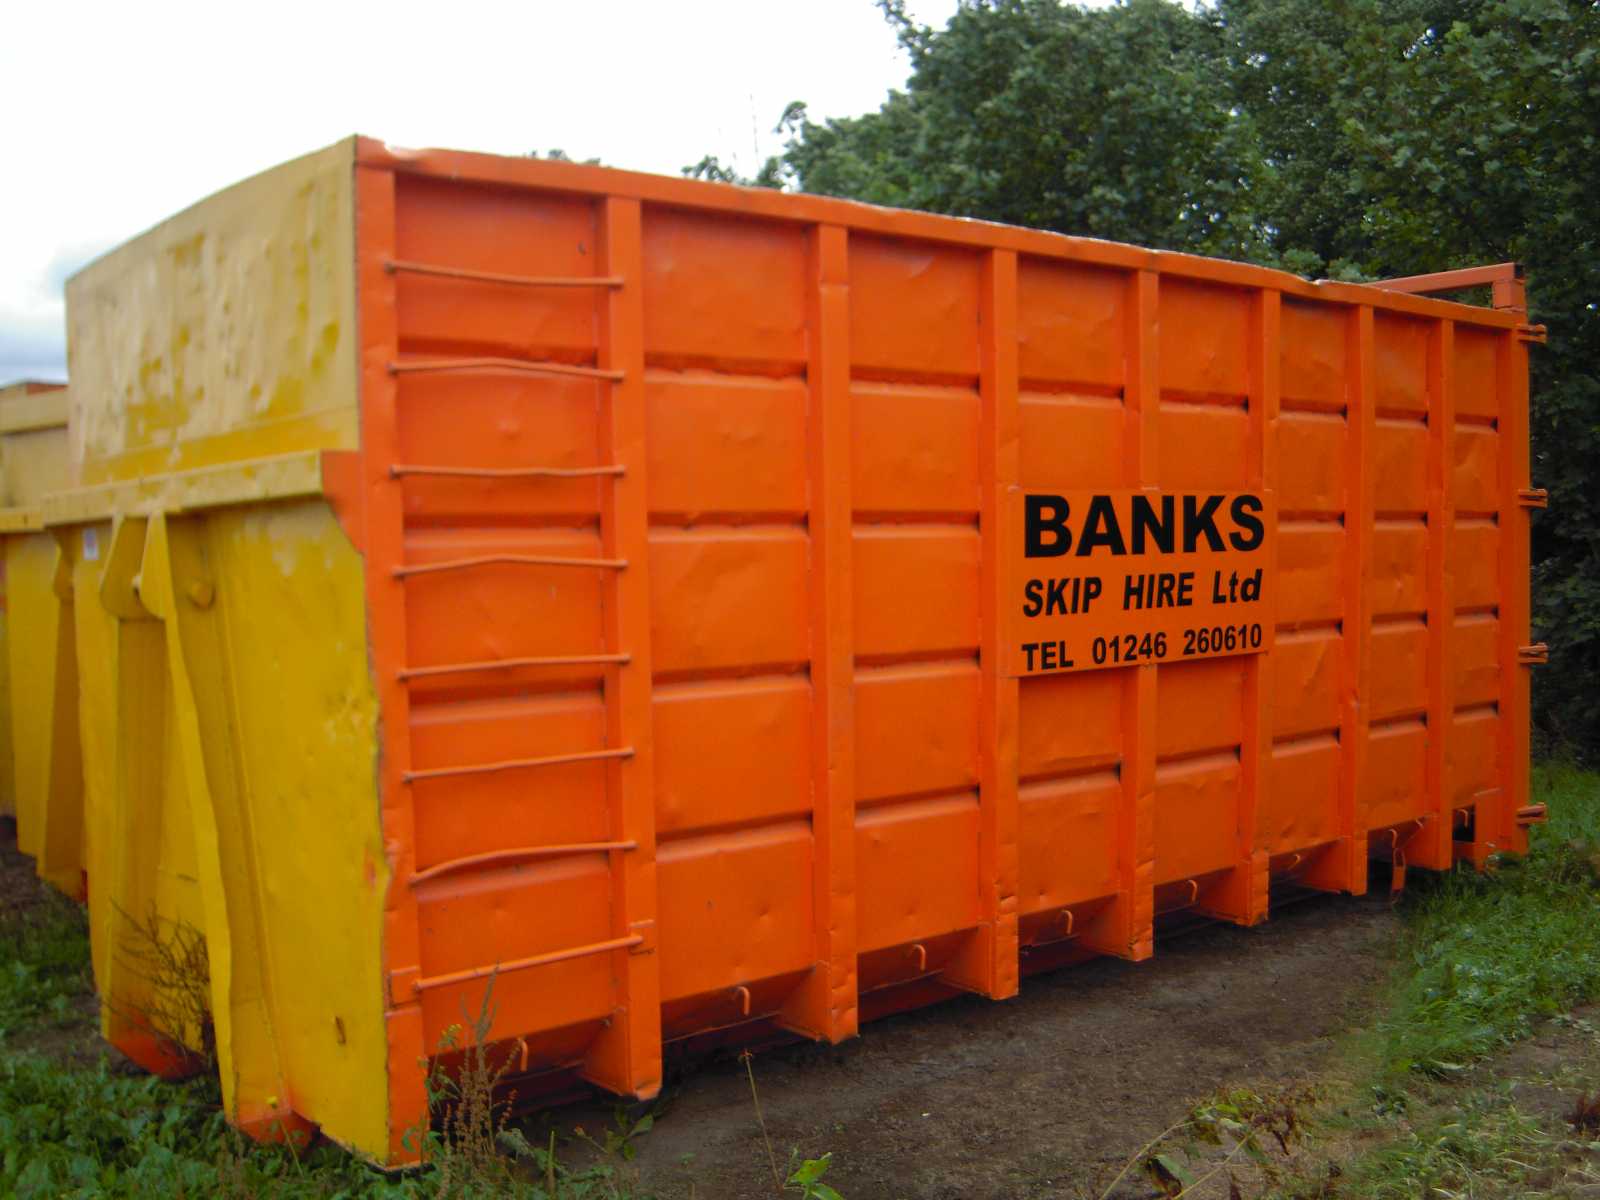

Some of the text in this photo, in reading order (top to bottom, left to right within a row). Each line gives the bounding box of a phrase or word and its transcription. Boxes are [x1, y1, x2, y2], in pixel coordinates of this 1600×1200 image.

[1024, 494, 1265, 558] BANKS
[1023, 568, 1263, 618] SKIP HIRE Ltd
[1021, 623, 1262, 672] TEL 01246 260610
